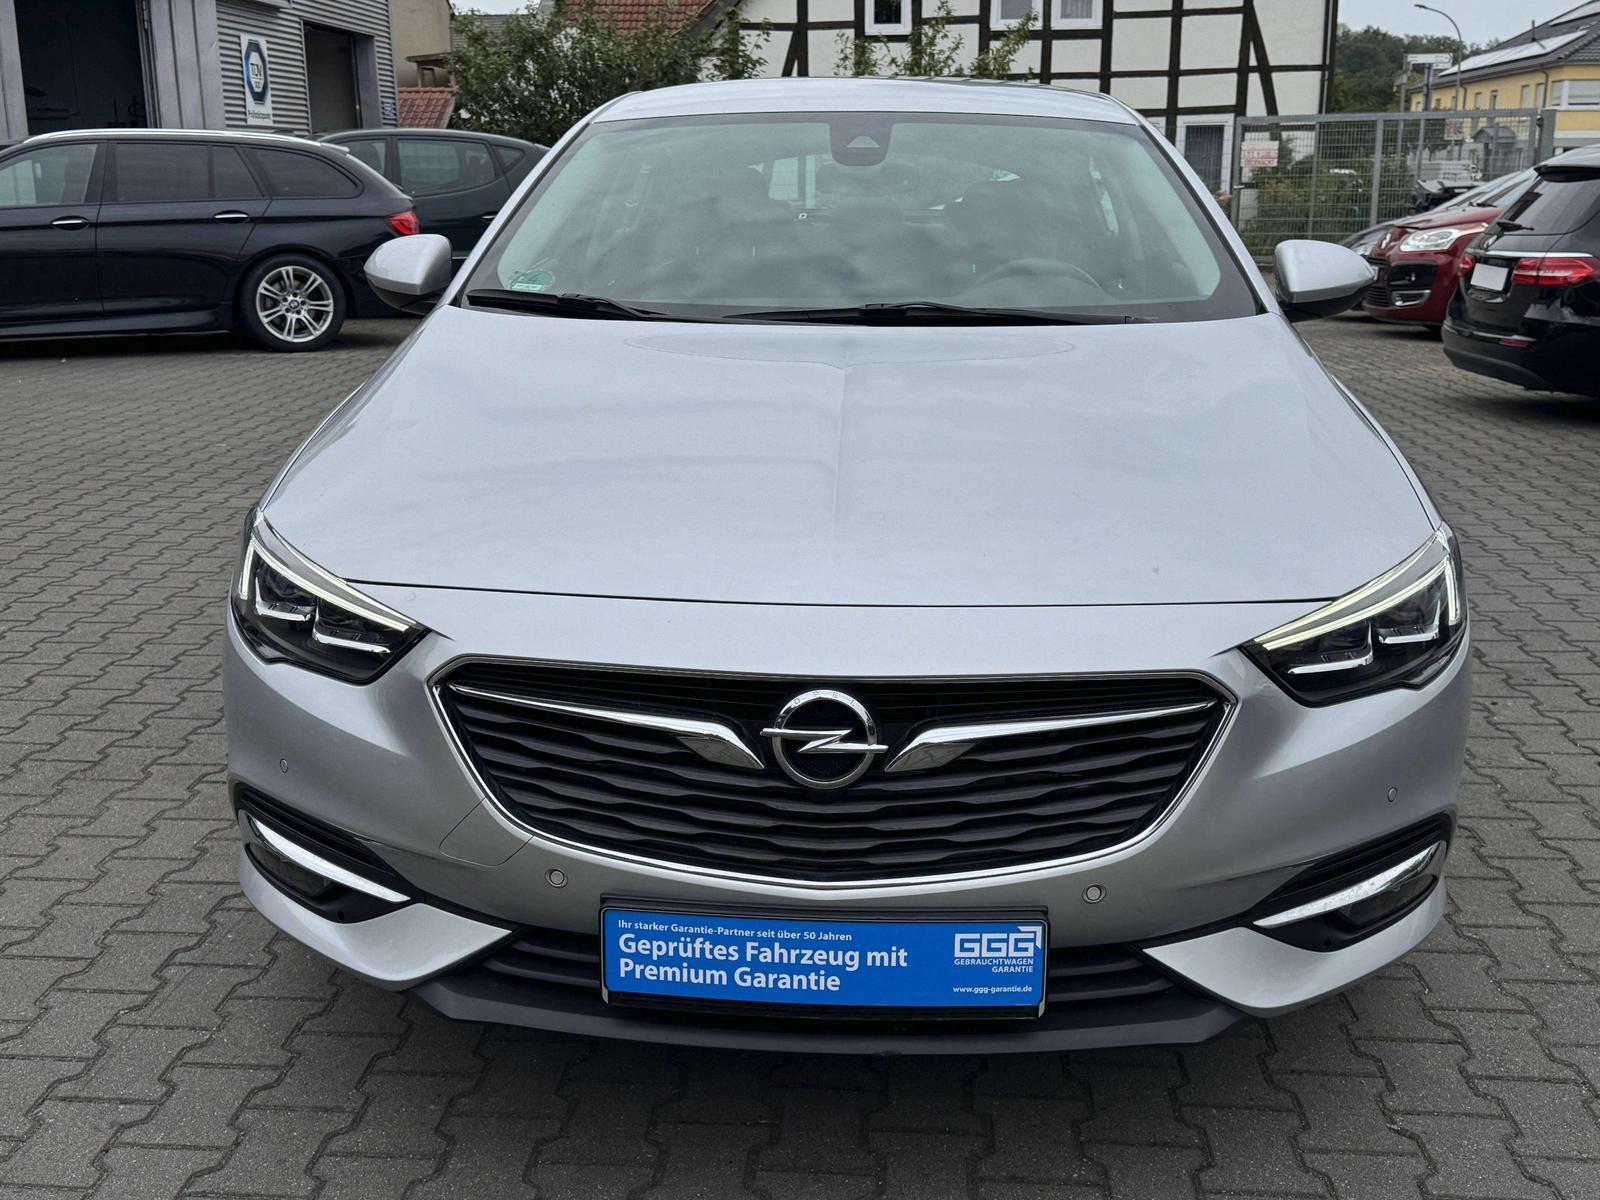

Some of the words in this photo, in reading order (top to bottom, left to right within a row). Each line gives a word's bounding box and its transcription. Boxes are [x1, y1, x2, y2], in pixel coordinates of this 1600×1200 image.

[618, 919, 632, 929] Ihr
[634, 921, 669, 932] starker
[671, 923, 755, 937] Garantie-Partner
[757, 929, 775, 938] seit
[777, 929, 801, 940] über
[803, 931, 816, 940] 50
[818, 931, 853, 942] Jahren
[618, 933, 739, 961] Geprüftes
[745, 941, 860, 972] Fahrzeug
[866, 945, 908, 967] mit
[954, 933, 1035, 957] GGG
[954, 958, 1034, 966] GEBRAUCHTWAGEN
[992, 965, 1034, 973] GARANTIE
[619, 958, 727, 985] Premium
[734, 966, 841, 991] Garantie
[953, 985, 1033, 994] www.ggg-garantie.de
